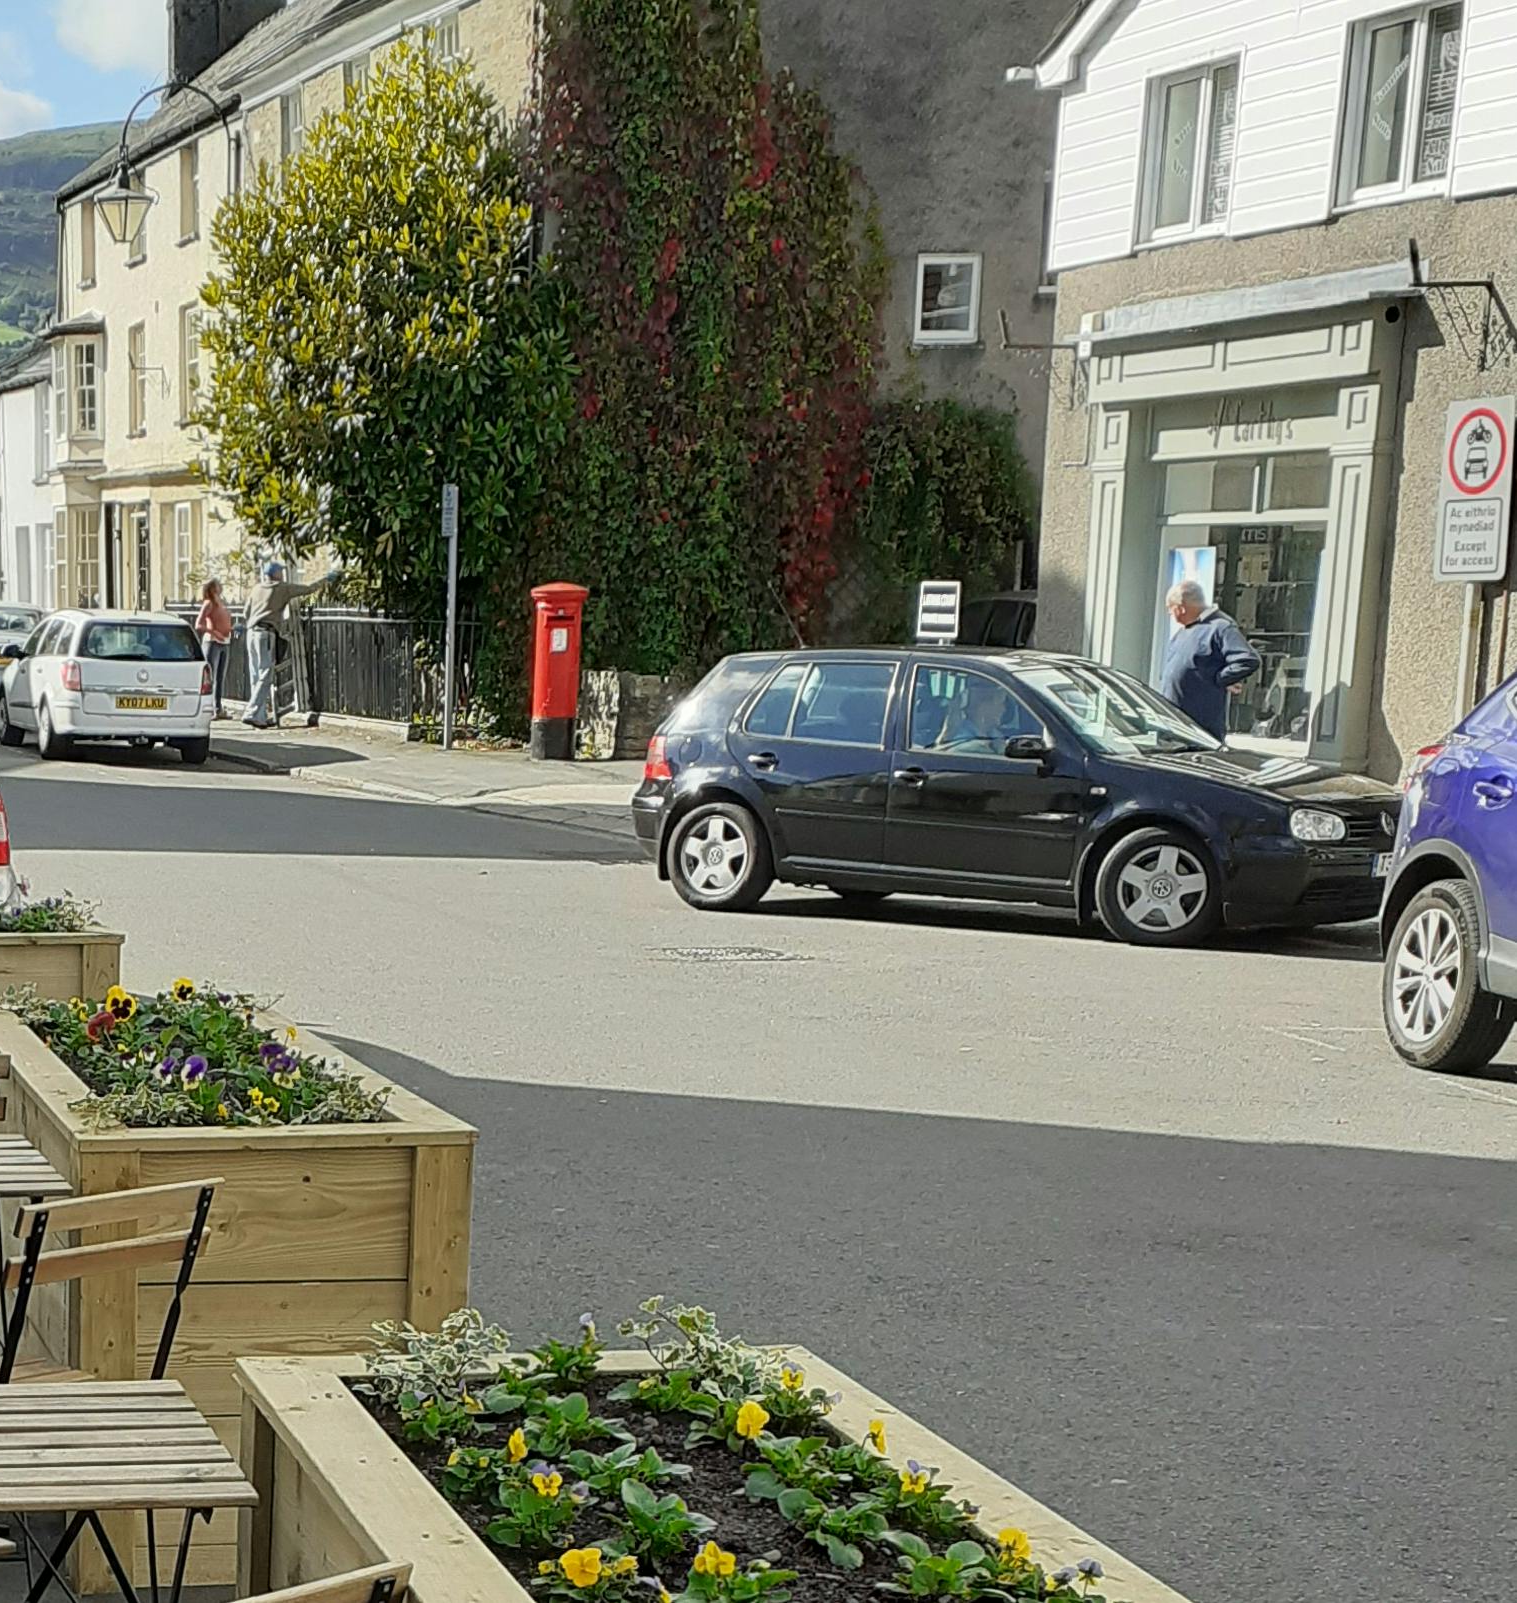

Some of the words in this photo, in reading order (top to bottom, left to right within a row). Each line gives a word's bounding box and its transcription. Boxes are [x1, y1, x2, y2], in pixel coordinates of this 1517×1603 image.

[1450, 507, 1462, 518] Ac
[1449, 520, 1495, 535] mynediad
[1454, 541, 1487, 552] Except
[1445, 555, 1459, 566] for
[1462, 556, 1493, 566] access
